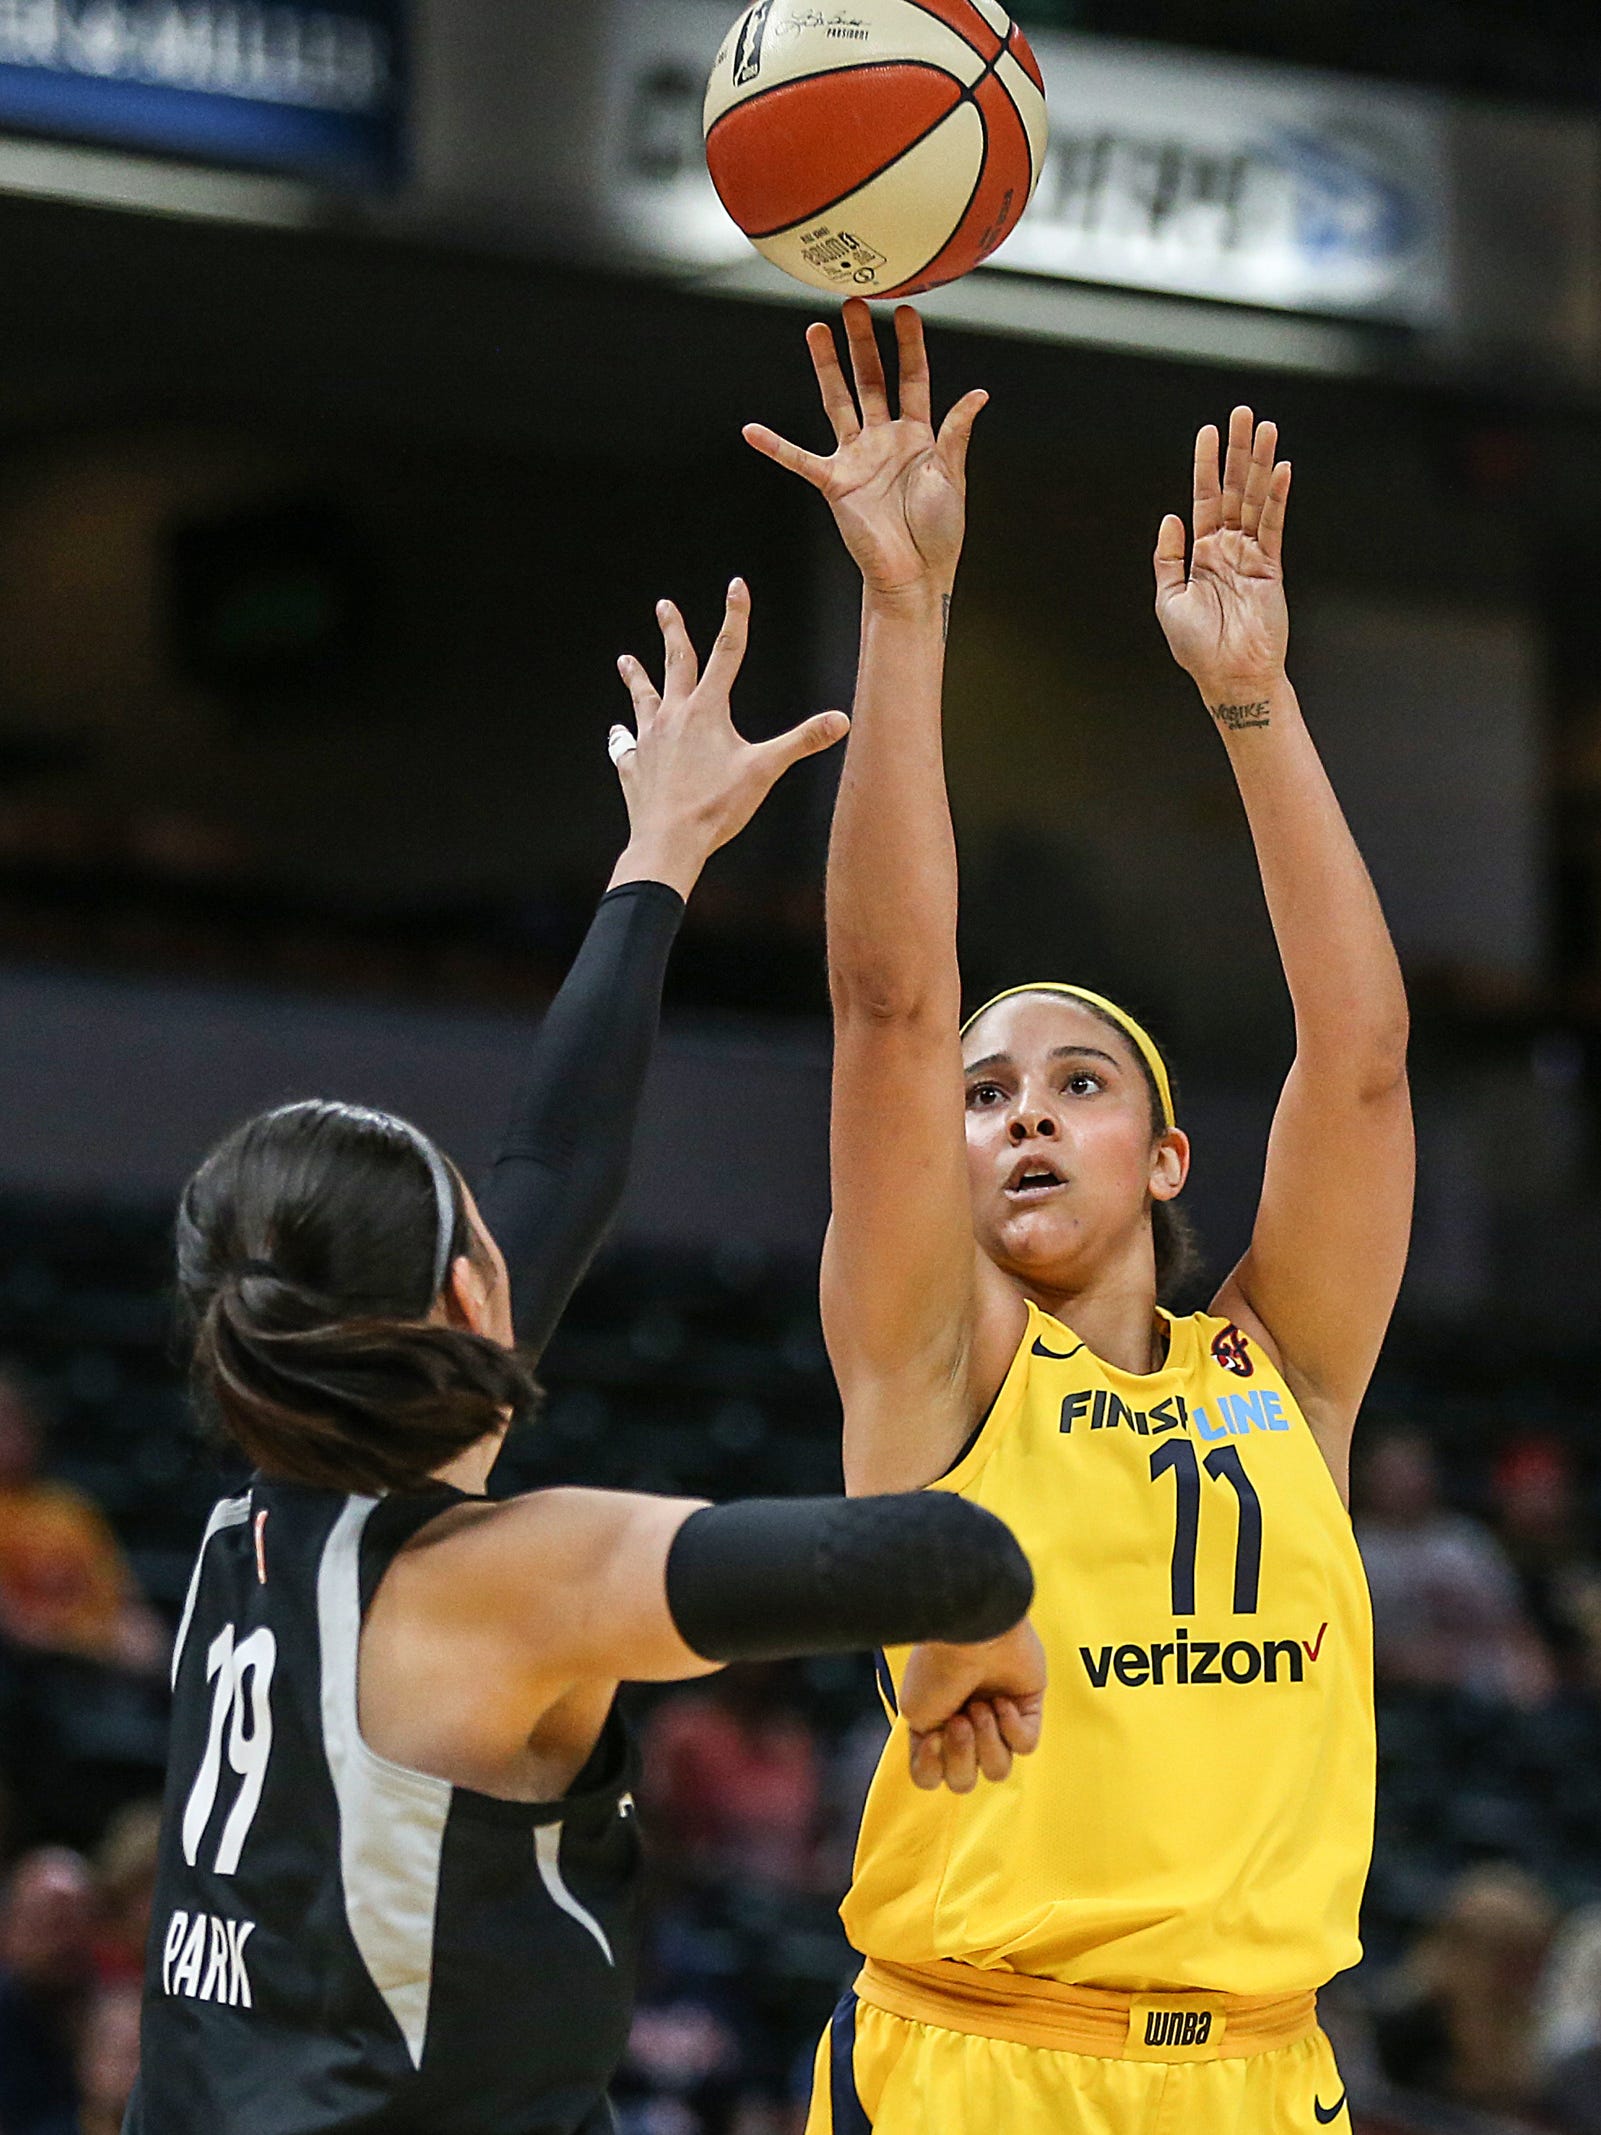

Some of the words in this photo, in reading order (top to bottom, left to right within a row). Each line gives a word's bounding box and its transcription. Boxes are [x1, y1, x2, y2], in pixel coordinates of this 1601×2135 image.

[1192, 1390, 1290, 1441] LINE
[1149, 1438, 1262, 1616] 11
[1079, 1628, 1304, 1689] verizon
[182, 1622, 277, 1875] 19
[163, 1909, 256, 2009] PARK
